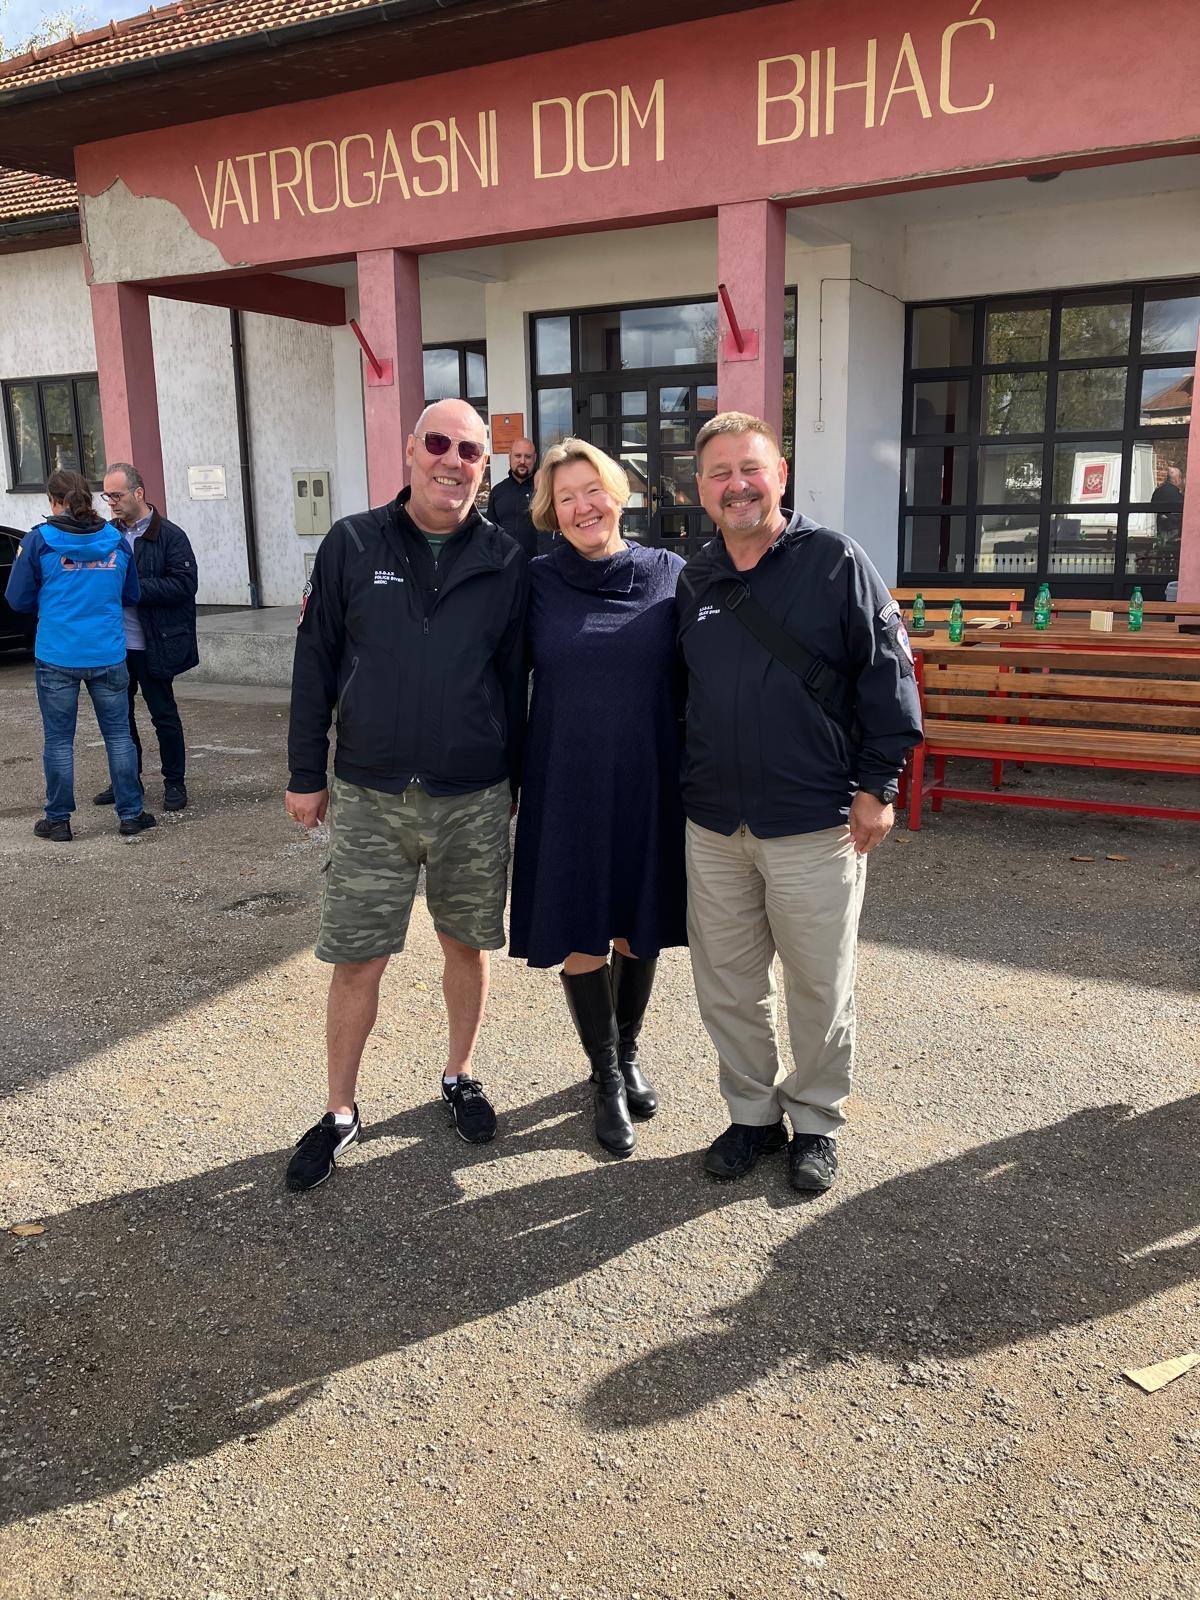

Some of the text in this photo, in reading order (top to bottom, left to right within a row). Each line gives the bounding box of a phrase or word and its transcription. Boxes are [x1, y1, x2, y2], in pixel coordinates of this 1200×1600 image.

[194, 0, 996, 230] VATROGASNI DOM BIHAĆ
